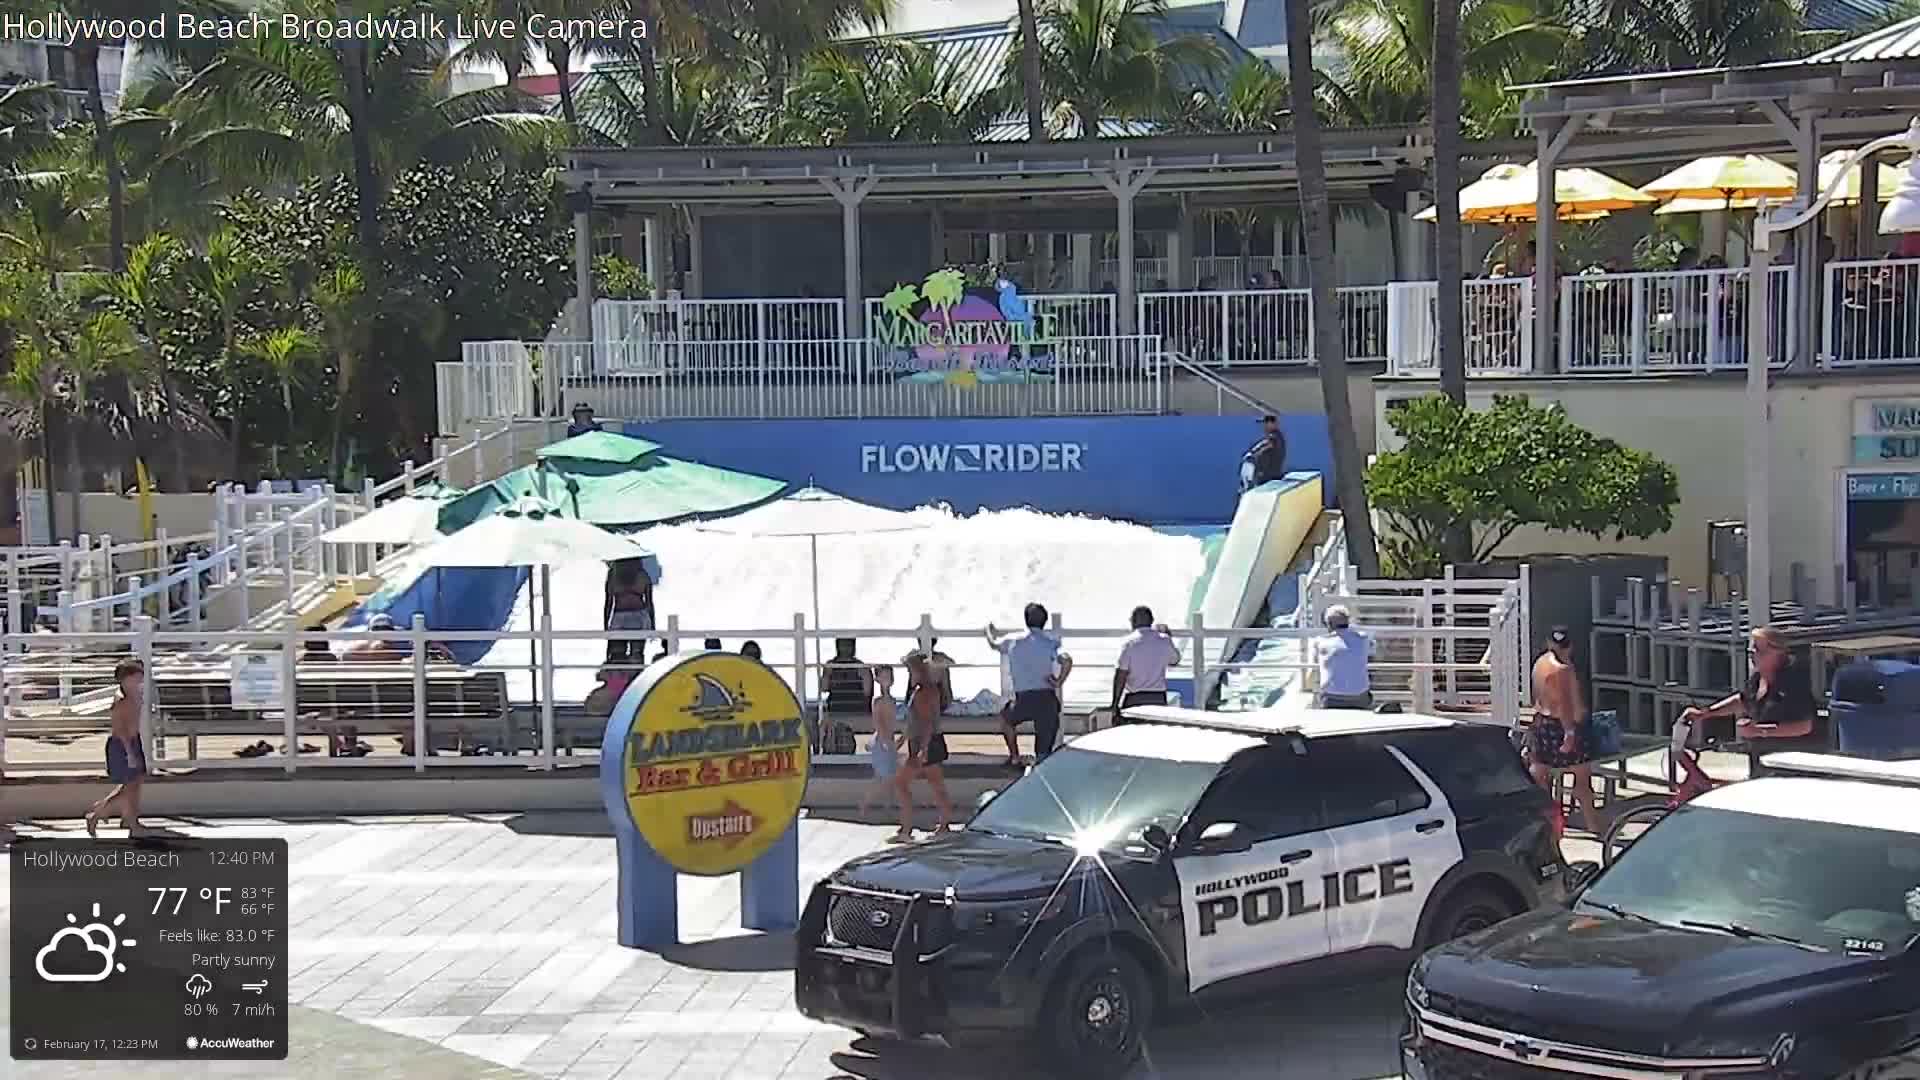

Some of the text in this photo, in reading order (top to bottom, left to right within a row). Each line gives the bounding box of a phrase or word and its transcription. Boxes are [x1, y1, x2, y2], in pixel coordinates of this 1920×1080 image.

[696, 760, 721, 785] &
[1195, 867, 1289, 896] HOLLYWOOD
[1197, 857, 1414, 937] POLICE
